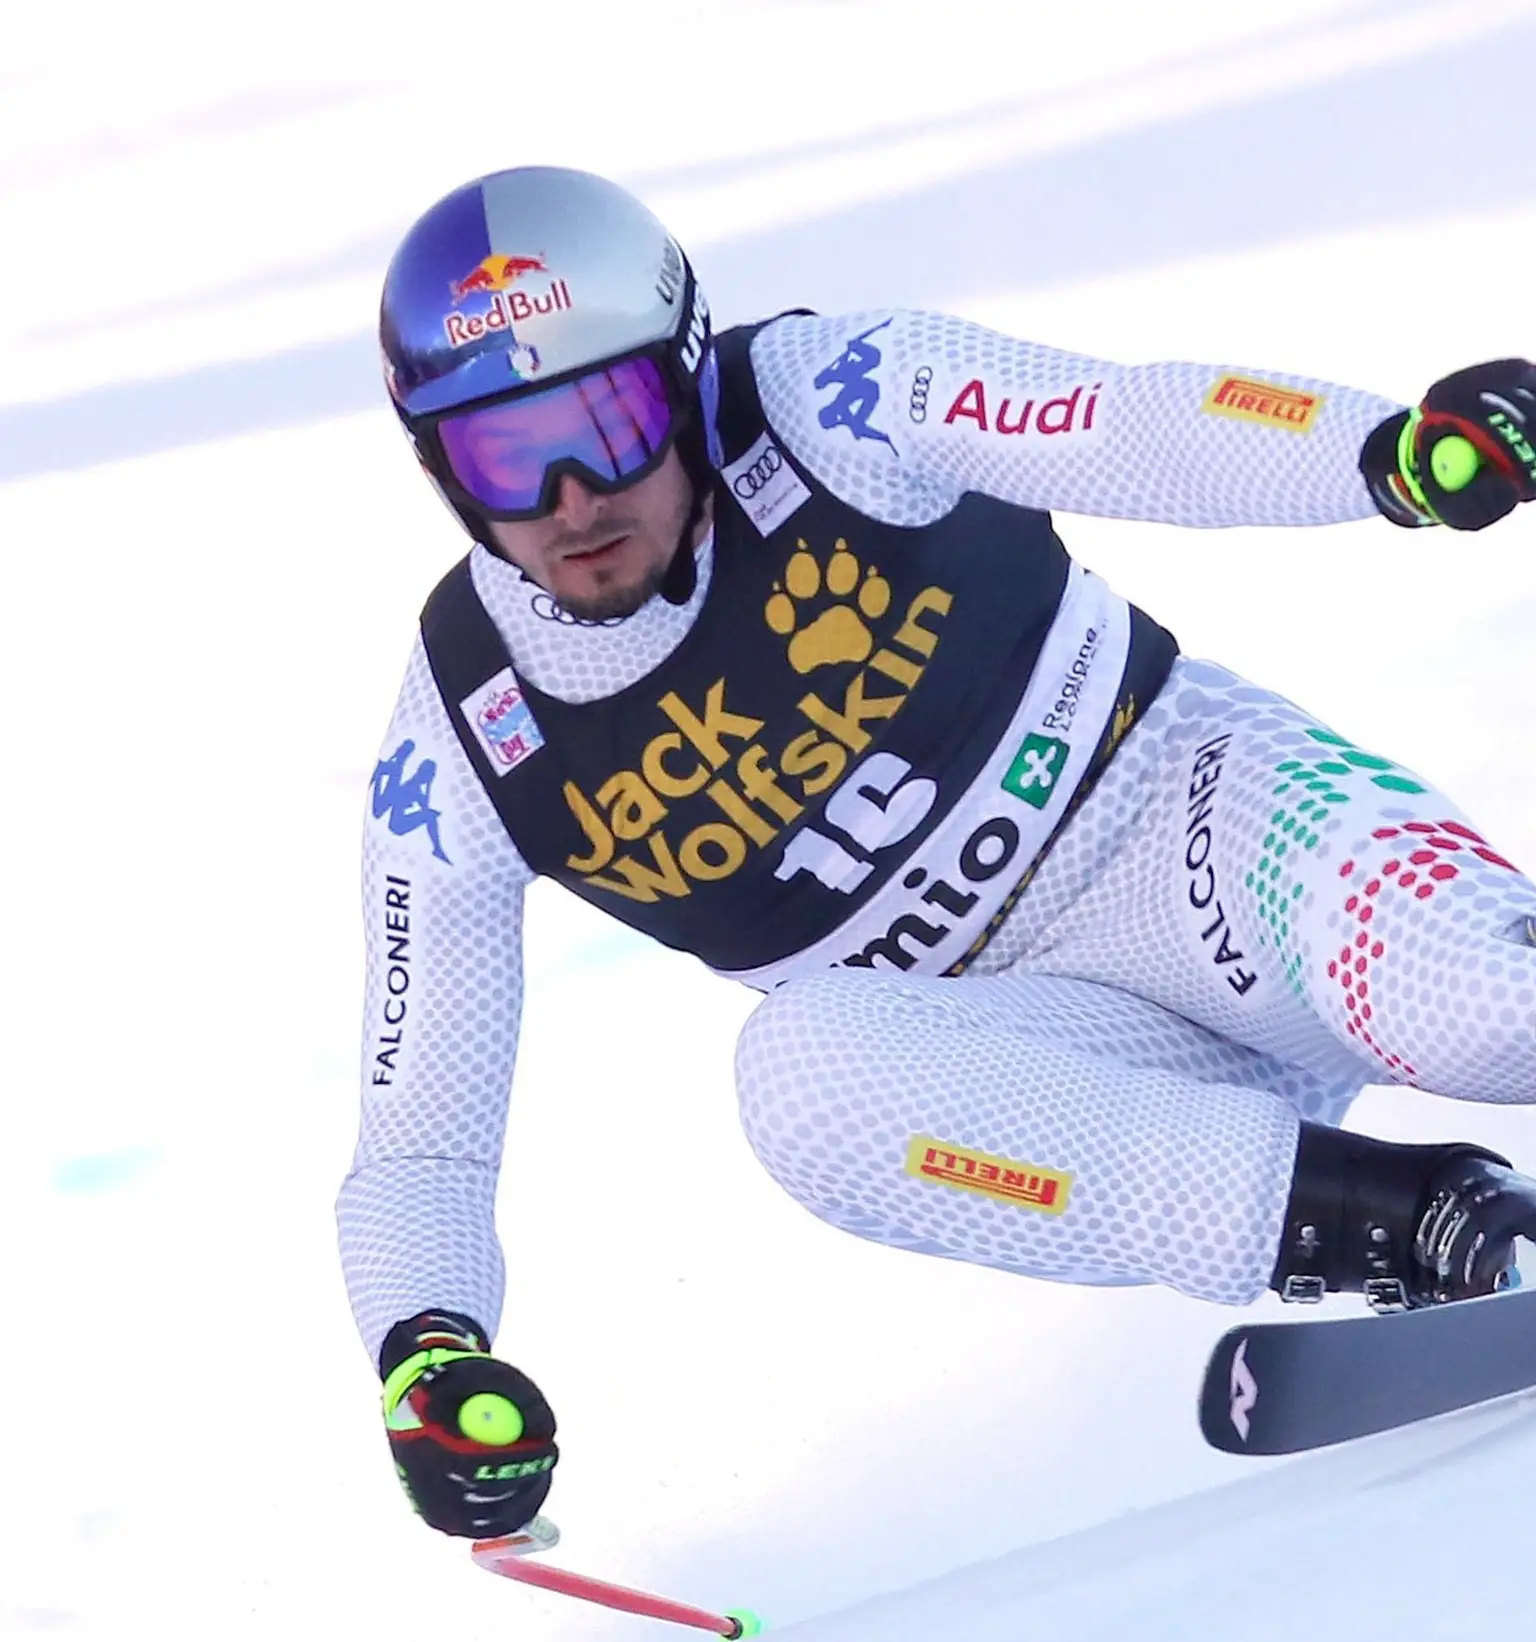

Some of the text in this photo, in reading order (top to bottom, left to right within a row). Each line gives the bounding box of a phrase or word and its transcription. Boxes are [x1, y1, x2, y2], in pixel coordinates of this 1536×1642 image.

[445, 278, 572, 347] Red Bull
[943, 377, 1103, 435] Audi
[1212, 377, 1315, 425] PIRELLI
[564, 677, 766, 874] Jack
[582, 584, 956, 903] Wolfskin
[829, 816, 1020, 973] mio
[1186, 732, 1259, 997] FALCONERI
[372, 874, 411, 1086] FALCONERI
[920, 1147, 1059, 1206] PIRELLI
